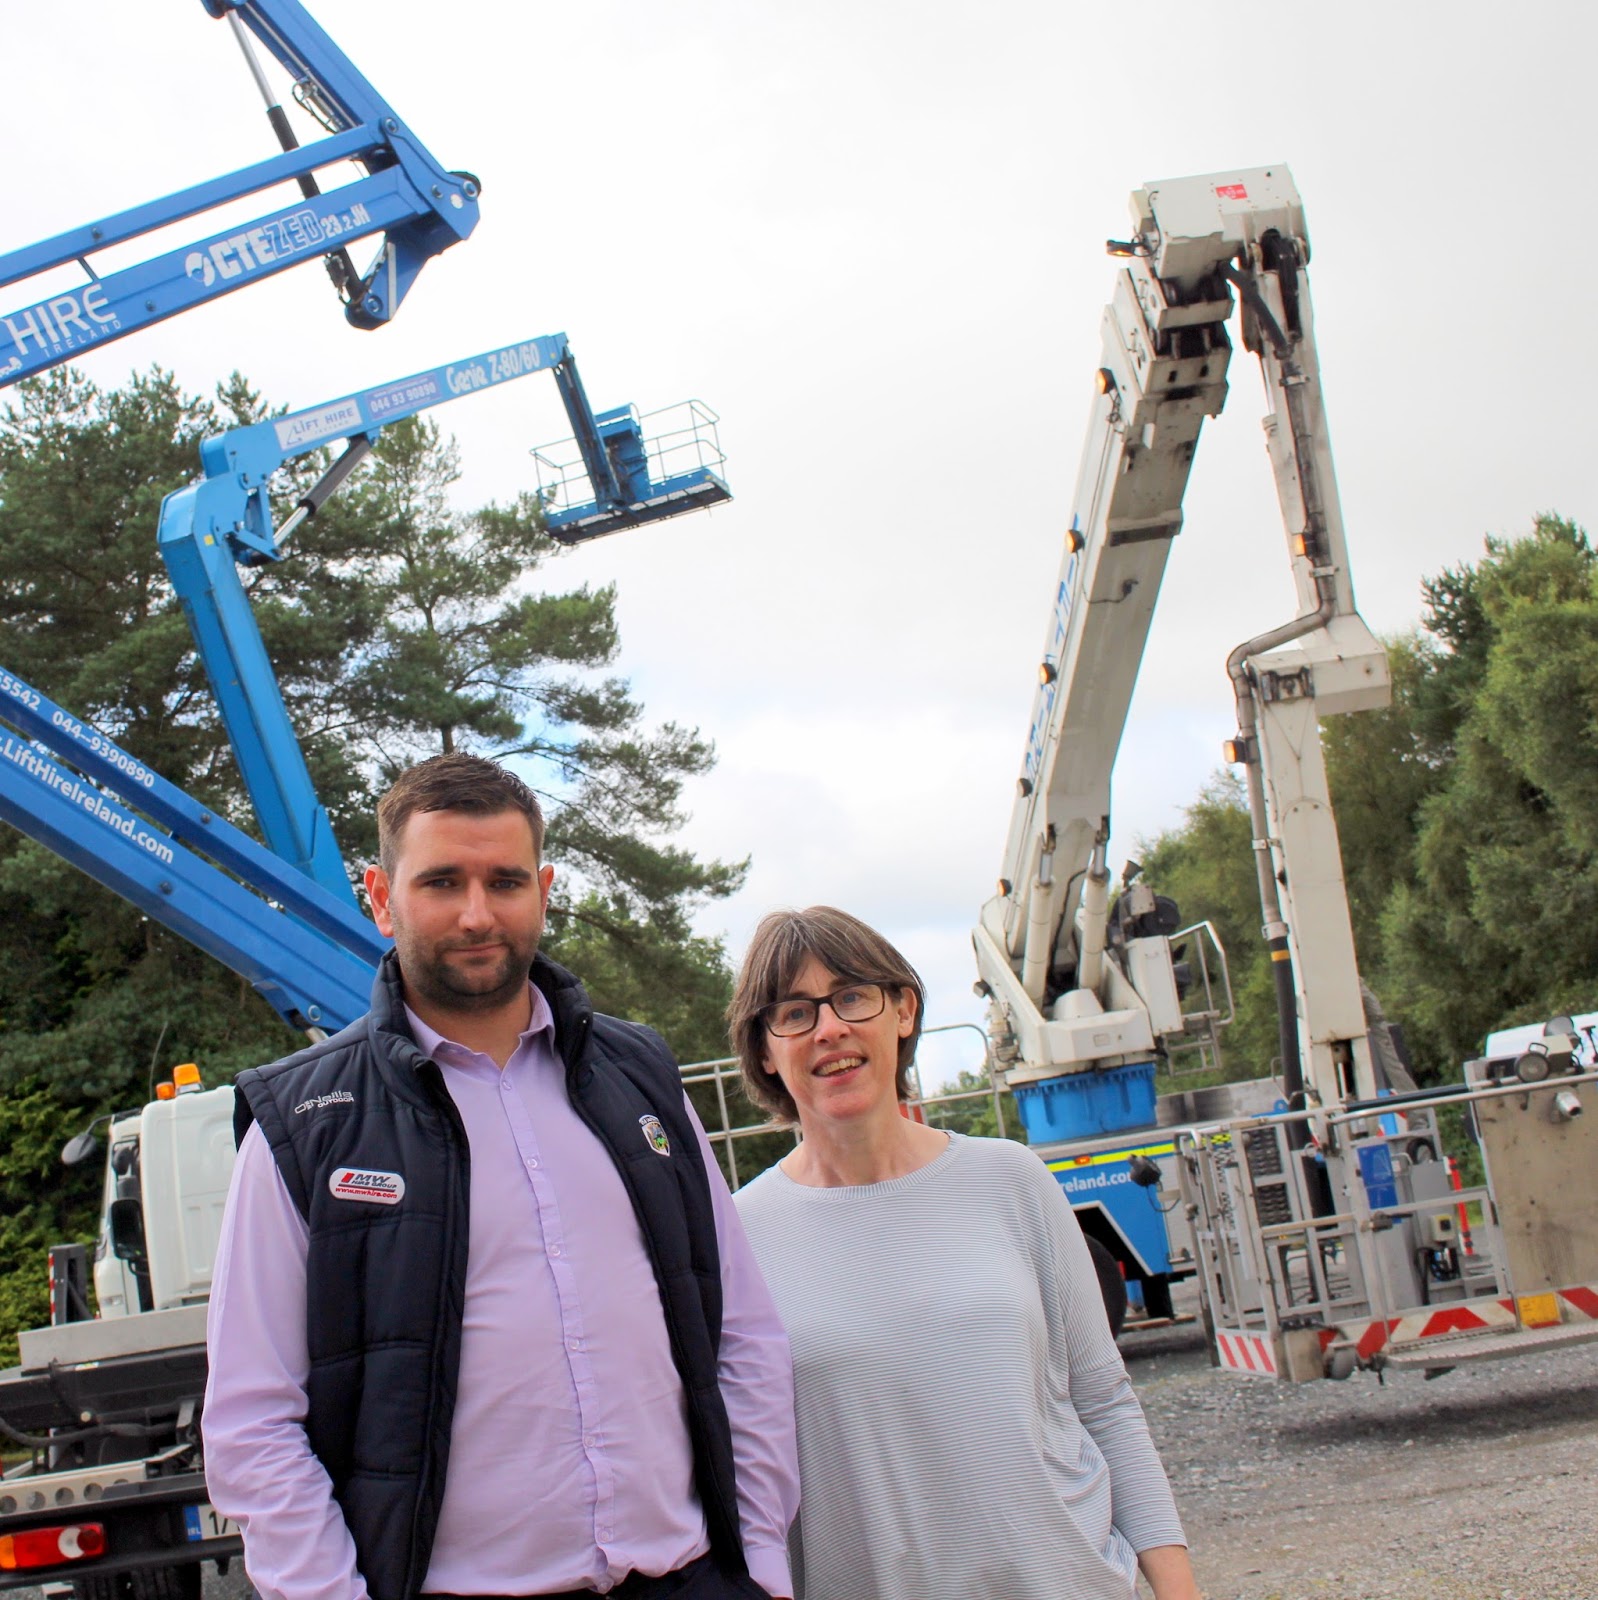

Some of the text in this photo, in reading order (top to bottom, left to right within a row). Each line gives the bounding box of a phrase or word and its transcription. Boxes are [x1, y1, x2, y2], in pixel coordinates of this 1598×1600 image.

[4, 284, 117, 356] HIRE
[44, 320, 121, 358] IRELAND
[445, 362, 489, 395] Genie
[370, 396, 391, 413] 044
[391, 391, 406, 406] 93
[292, 418, 320, 434] LIFT
[324, 406, 354, 424] HIRE
[0, 670, 41, 712] 5542
[0, 736, 174, 864] .LiftHireIreland.com
[355, 1173, 391, 1183] MW
